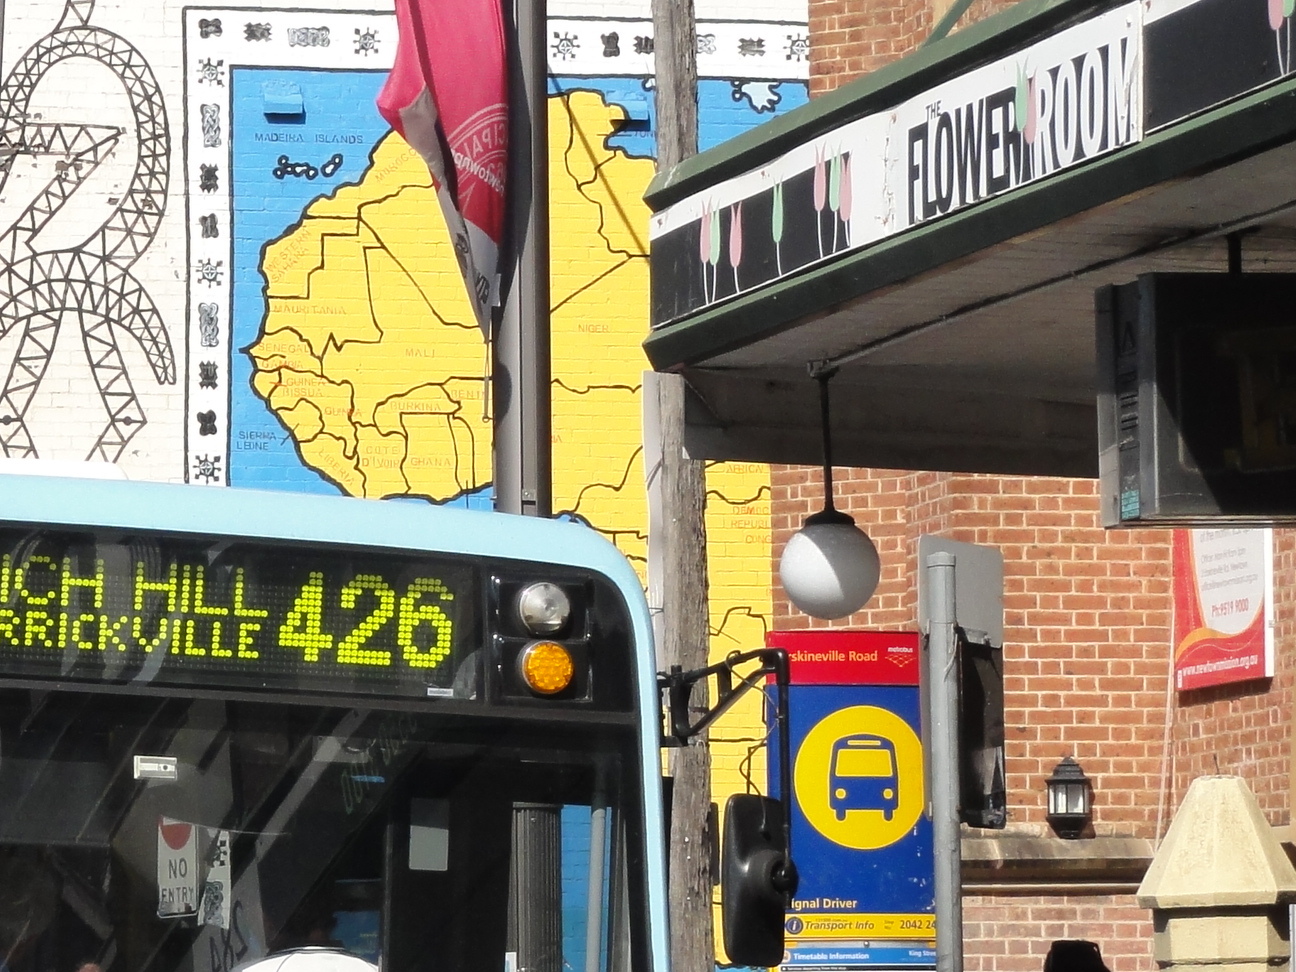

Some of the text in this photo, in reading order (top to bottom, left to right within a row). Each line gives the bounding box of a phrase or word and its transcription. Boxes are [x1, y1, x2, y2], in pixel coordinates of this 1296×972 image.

[926, 100, 942, 120] THE
[908, 36, 1139, 226] FLOWER ROOM
[255, 132, 364, 145] MADEIRA ISLANDS
[266, 228, 313, 273] WESTERN
[271, 246, 311, 283] SAHARA
[274, 303, 347, 317] MAURITANIA
[578, 323, 610, 334] NIGER
[258, 341, 309, 354] SENEGAL
[405, 348, 436, 359] MALI
[286, 377, 327, 388] GUINEA
[451, 389, 485, 400] BENI
[390, 401, 442, 412] BURKINA
[238, 431, 277, 441] SIERRA
[236, 440, 270, 452] LEONE
[317, 447, 355, 487] LIBERIA
[410, 456, 452, 468] GHANA
[135, 561, 268, 618] HILL
[278, 570, 454, 670] 426
[786, 650, 878, 662] rskineville Road
[168, 857, 188, 879] NO
[161, 886, 195, 903] ENTRY
[791, 898, 858, 910] ignal Driver
[805, 920, 852, 931] Transport
[855, 920, 875, 930] Info
[900, 919, 923, 930] 2042
[793, 952, 870, 961] Timetable Information
